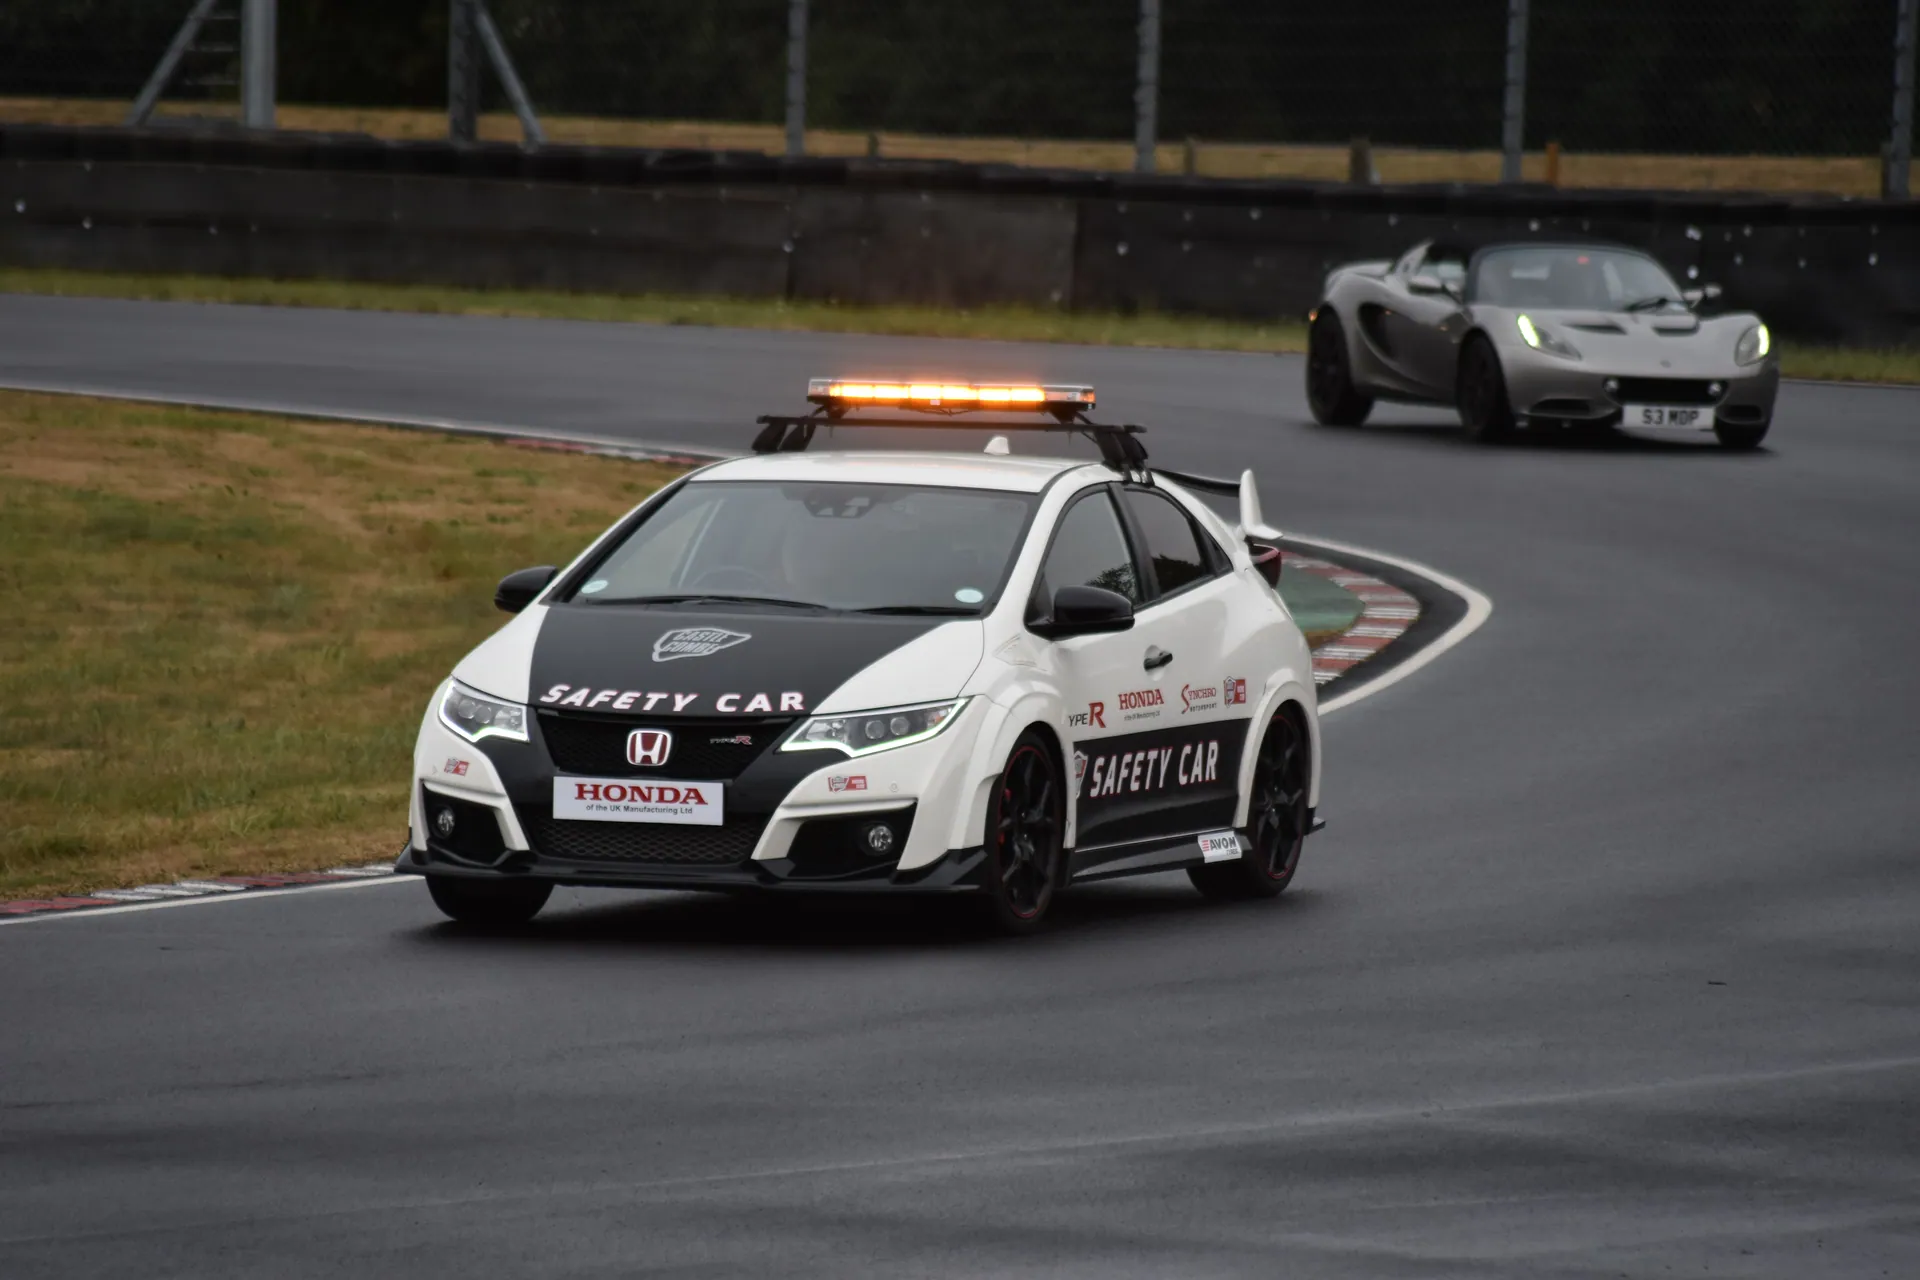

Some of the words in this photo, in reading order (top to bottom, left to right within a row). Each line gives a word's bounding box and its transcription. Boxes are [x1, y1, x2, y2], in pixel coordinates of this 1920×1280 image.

[1641, 408, 1664, 425] S3
[1668, 409, 1699, 426] MDP
[540, 684, 699, 712] SAFETY
[716, 692, 805, 712] CAR
[1118, 688, 1164, 710] HONDA
[1089, 746, 1173, 798] SAFETY
[1178, 740, 1219, 786] CAR
[574, 783, 709, 806] HONDA
[623, 805, 678, 815] Manufacturing
[1210, 836, 1237, 850] AVON
